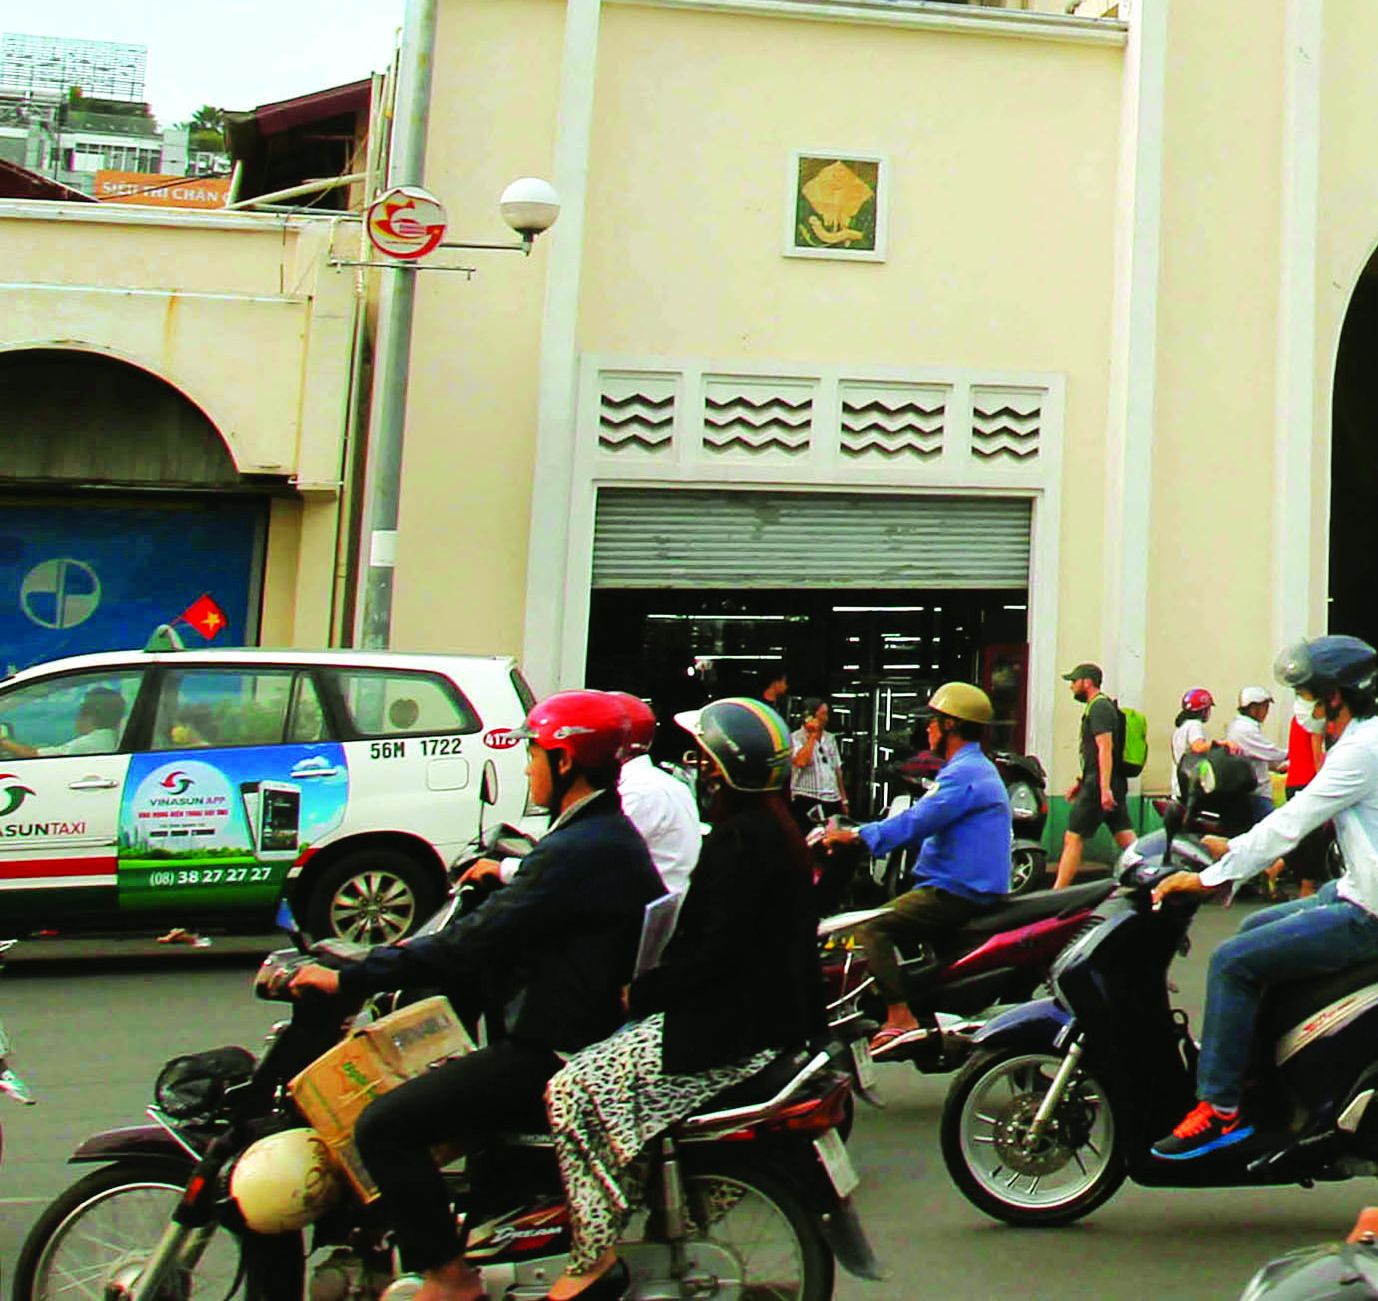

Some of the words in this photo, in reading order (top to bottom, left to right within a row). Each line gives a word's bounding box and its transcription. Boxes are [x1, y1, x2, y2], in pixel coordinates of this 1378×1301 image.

[420, 738, 462, 756] 1722
[150, 797, 204, 806] VINASUN
[150, 872, 174, 886] (08)
[178, 871, 198, 884] 38
[202, 870, 223, 883] 27
[226, 869, 247, 882] 27
[251, 867, 271, 880] 27
